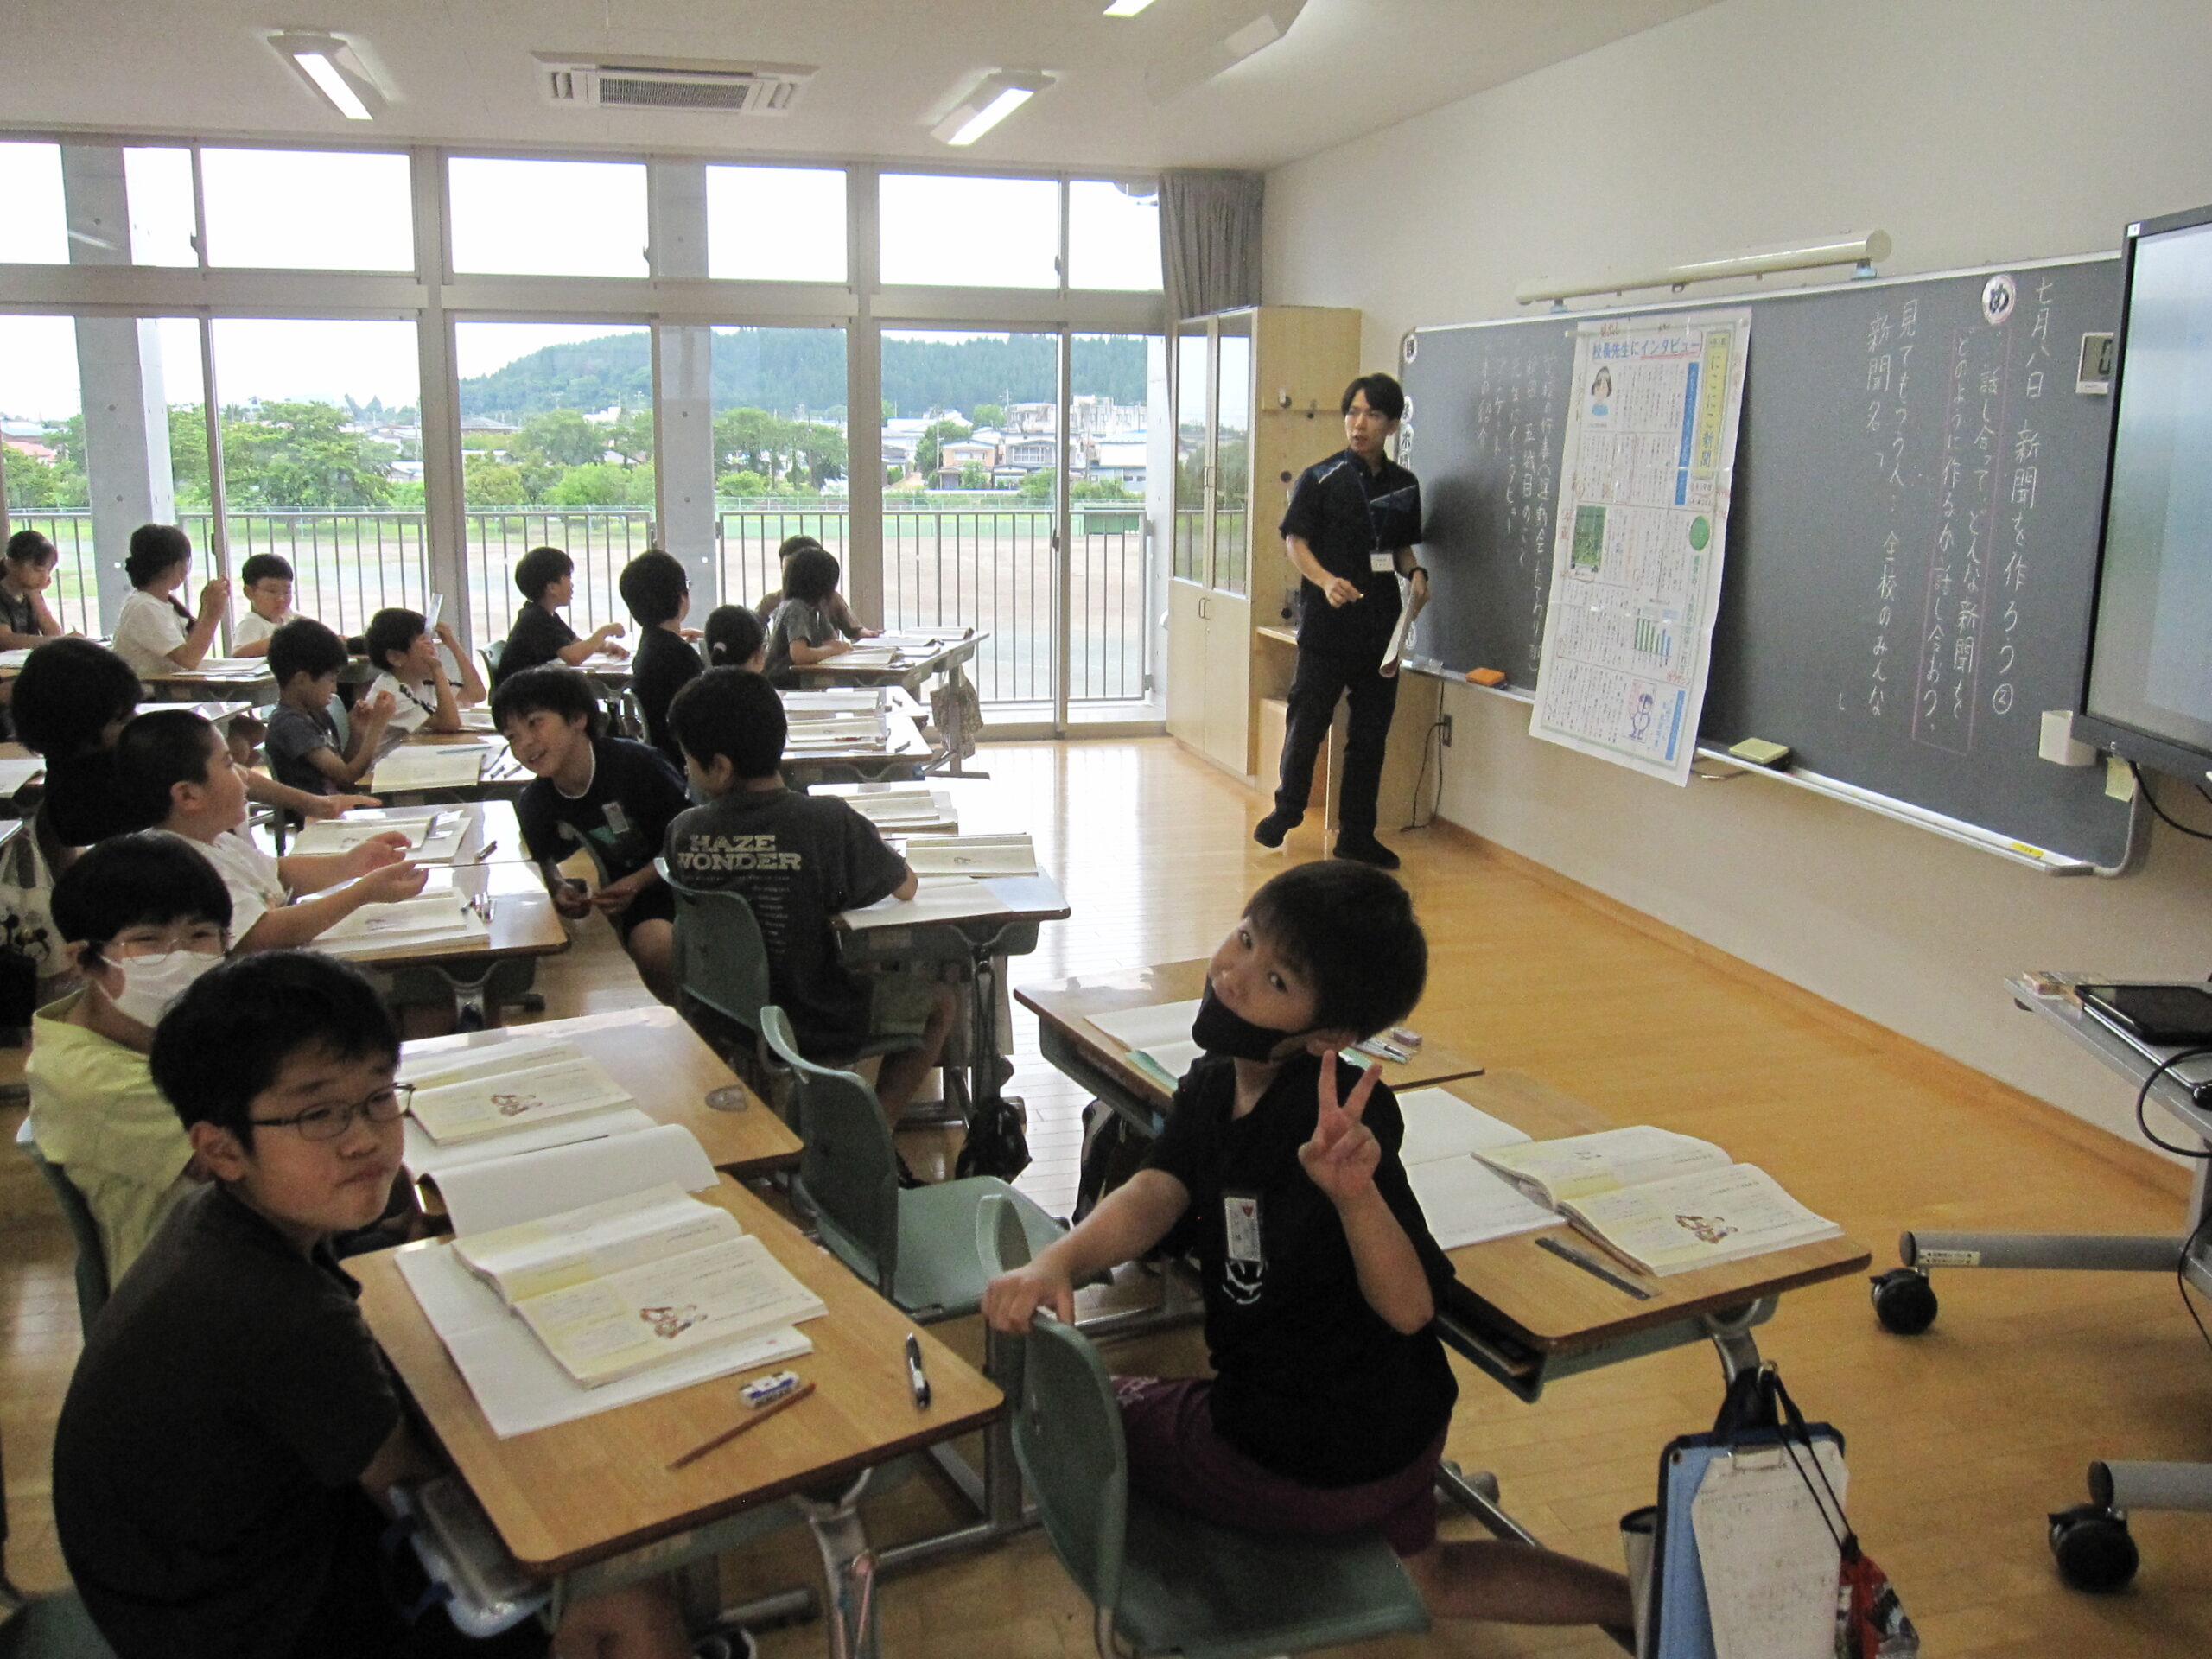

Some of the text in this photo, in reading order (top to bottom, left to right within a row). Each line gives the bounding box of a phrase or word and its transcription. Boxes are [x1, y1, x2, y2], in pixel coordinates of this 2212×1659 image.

[1988, 283, 2010, 314] め
[1592, 336, 1700, 360] 校長先生にインタビュー
[2025, 276, 2054, 398] 七月八日
[1700, 354, 1722, 467] にこにこ新聞
[690, 834, 776, 853] HAZE
[677, 852, 802, 871] WONDER
